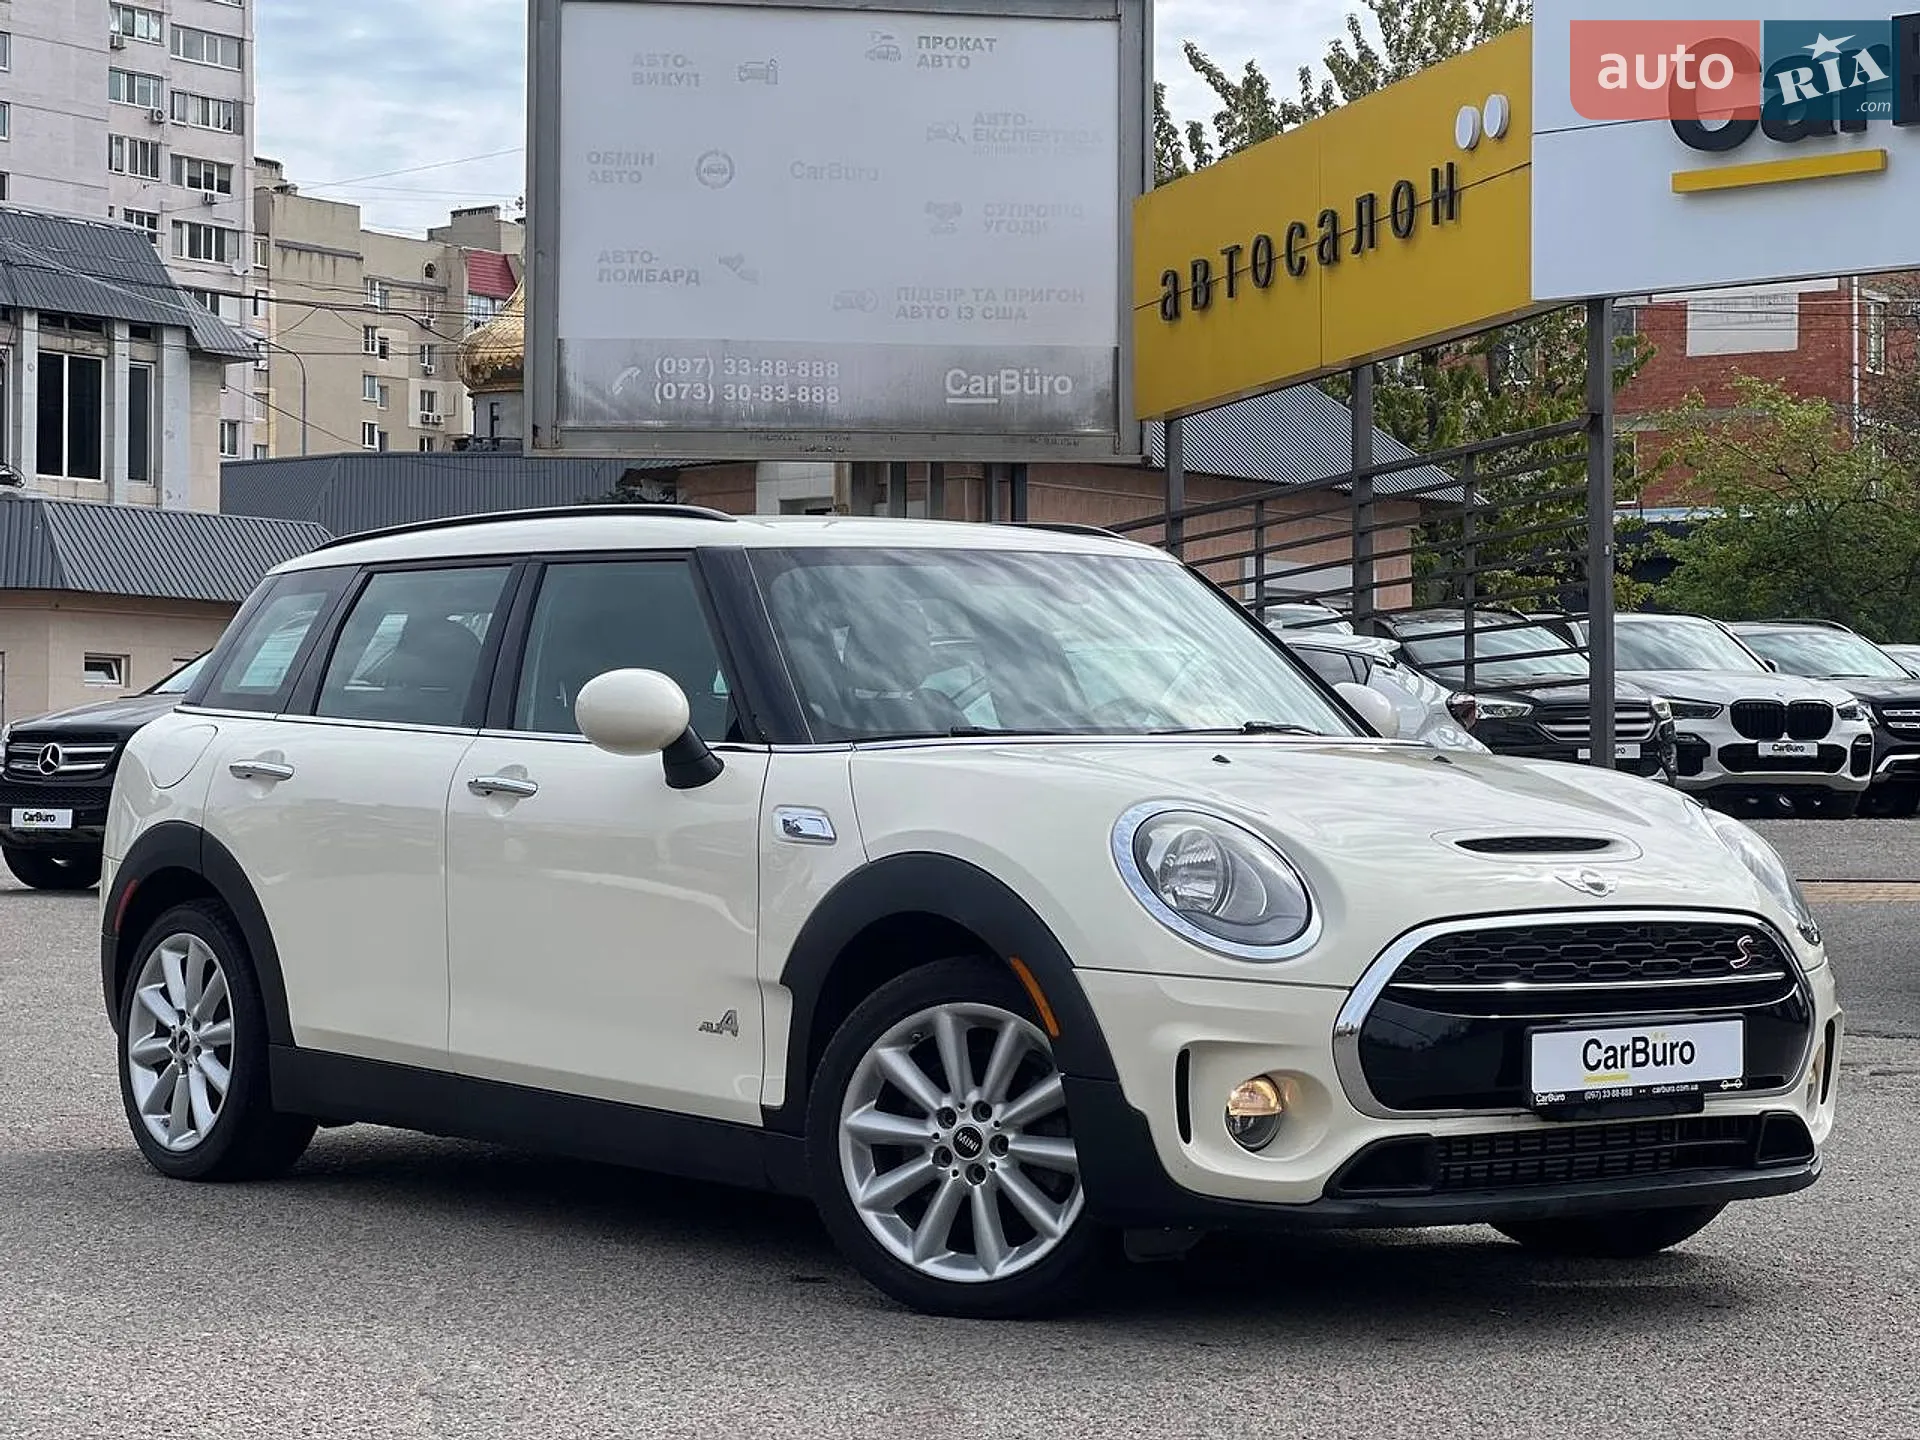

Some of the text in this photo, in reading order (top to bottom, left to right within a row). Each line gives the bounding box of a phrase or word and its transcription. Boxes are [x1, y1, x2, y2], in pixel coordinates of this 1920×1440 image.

[917, 35, 997, 52] ПРОКАТ
[631, 53, 694, 68] АВТО-
[917, 54, 971, 69] АВТО
[586, 151, 654, 167] ОБМІН
[588, 169, 643, 185] АВТО
[1161, 162, 1459, 321] автосалон
[598, 249, 660, 264] АВТО-
[597, 267, 700, 287] ЛОМБАРД
[896, 286, 1085, 304] ПІДБІР ТА ПРИГОН
[895, 306, 1028, 321] АВТО ІЗ США
[655, 357, 840, 379] (097) 33-88-888
[945, 367, 1073, 396] CarBüro
[654, 382, 840, 404] (073) 30-83-888
[1582, 1032, 1695, 1071] CarBüro
[957, 1132, 979, 1152] MINI
